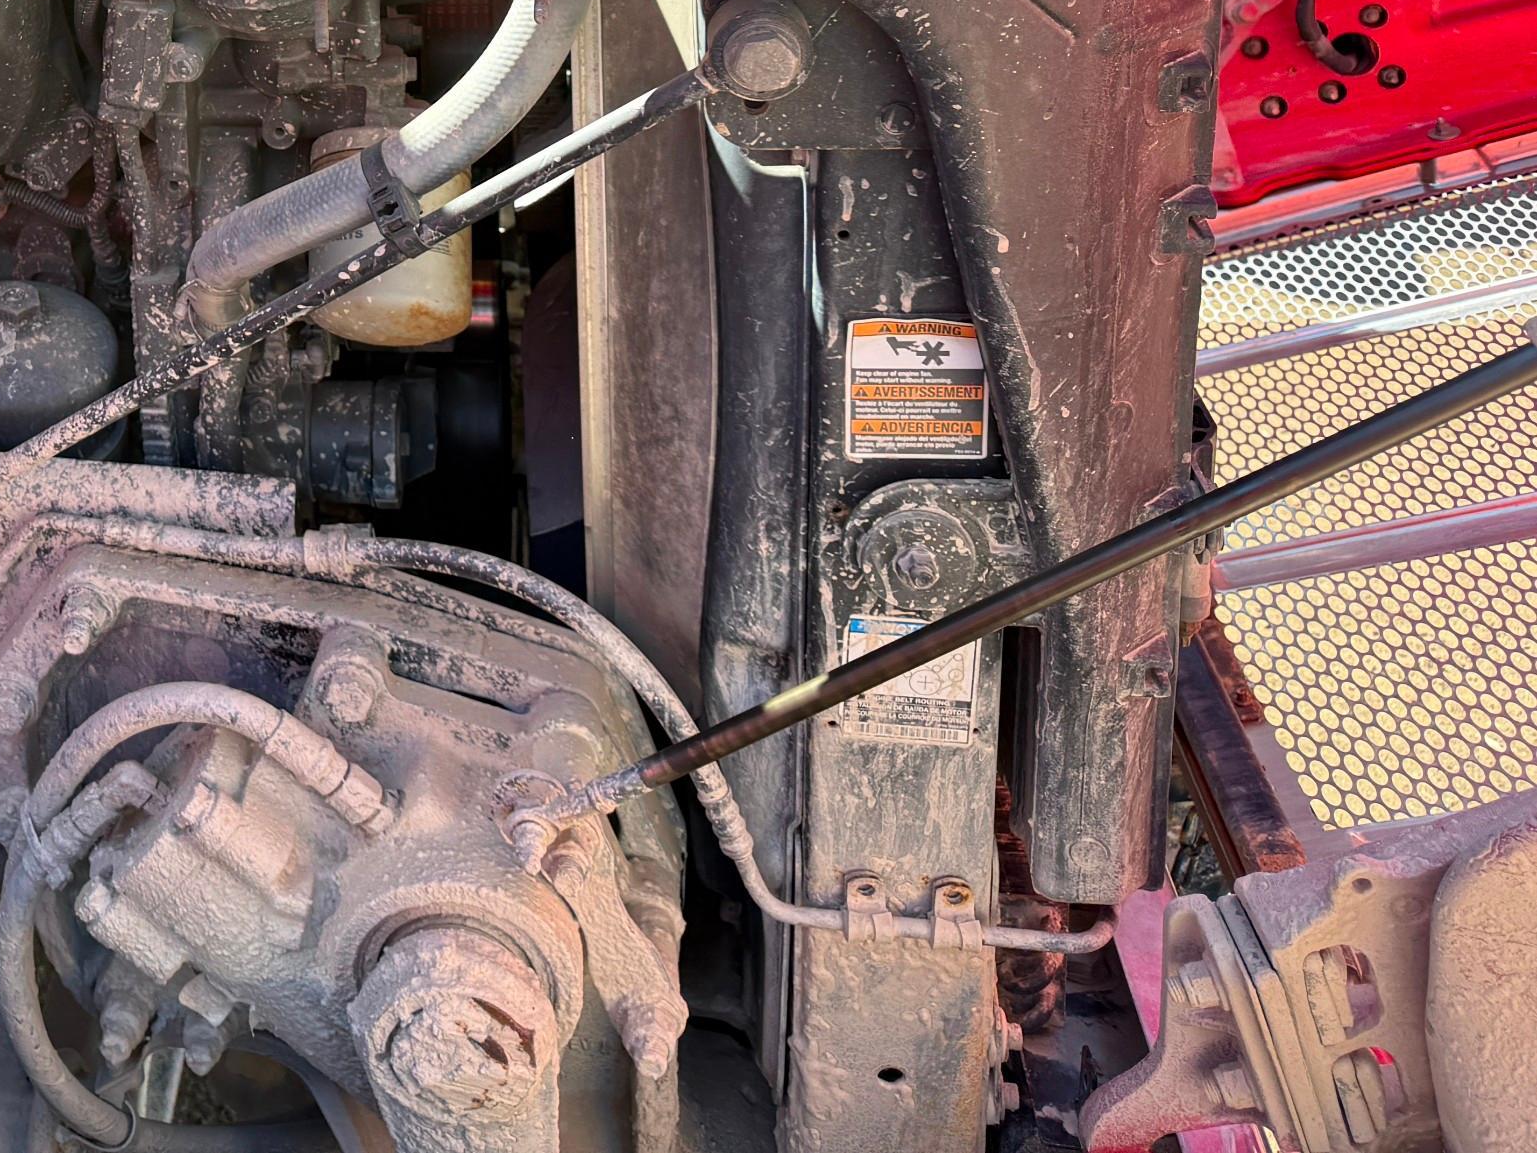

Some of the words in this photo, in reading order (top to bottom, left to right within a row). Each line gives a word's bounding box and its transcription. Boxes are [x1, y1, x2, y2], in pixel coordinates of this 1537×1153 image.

[896, 323, 961, 336] WARNING
[873, 387, 980, 398] AVERTISSEMENT
[880, 422, 973, 433] ADVERTENCIA
[915, 697, 950, 706] ROUTING
[940, 708, 967, 716] MOTOR
